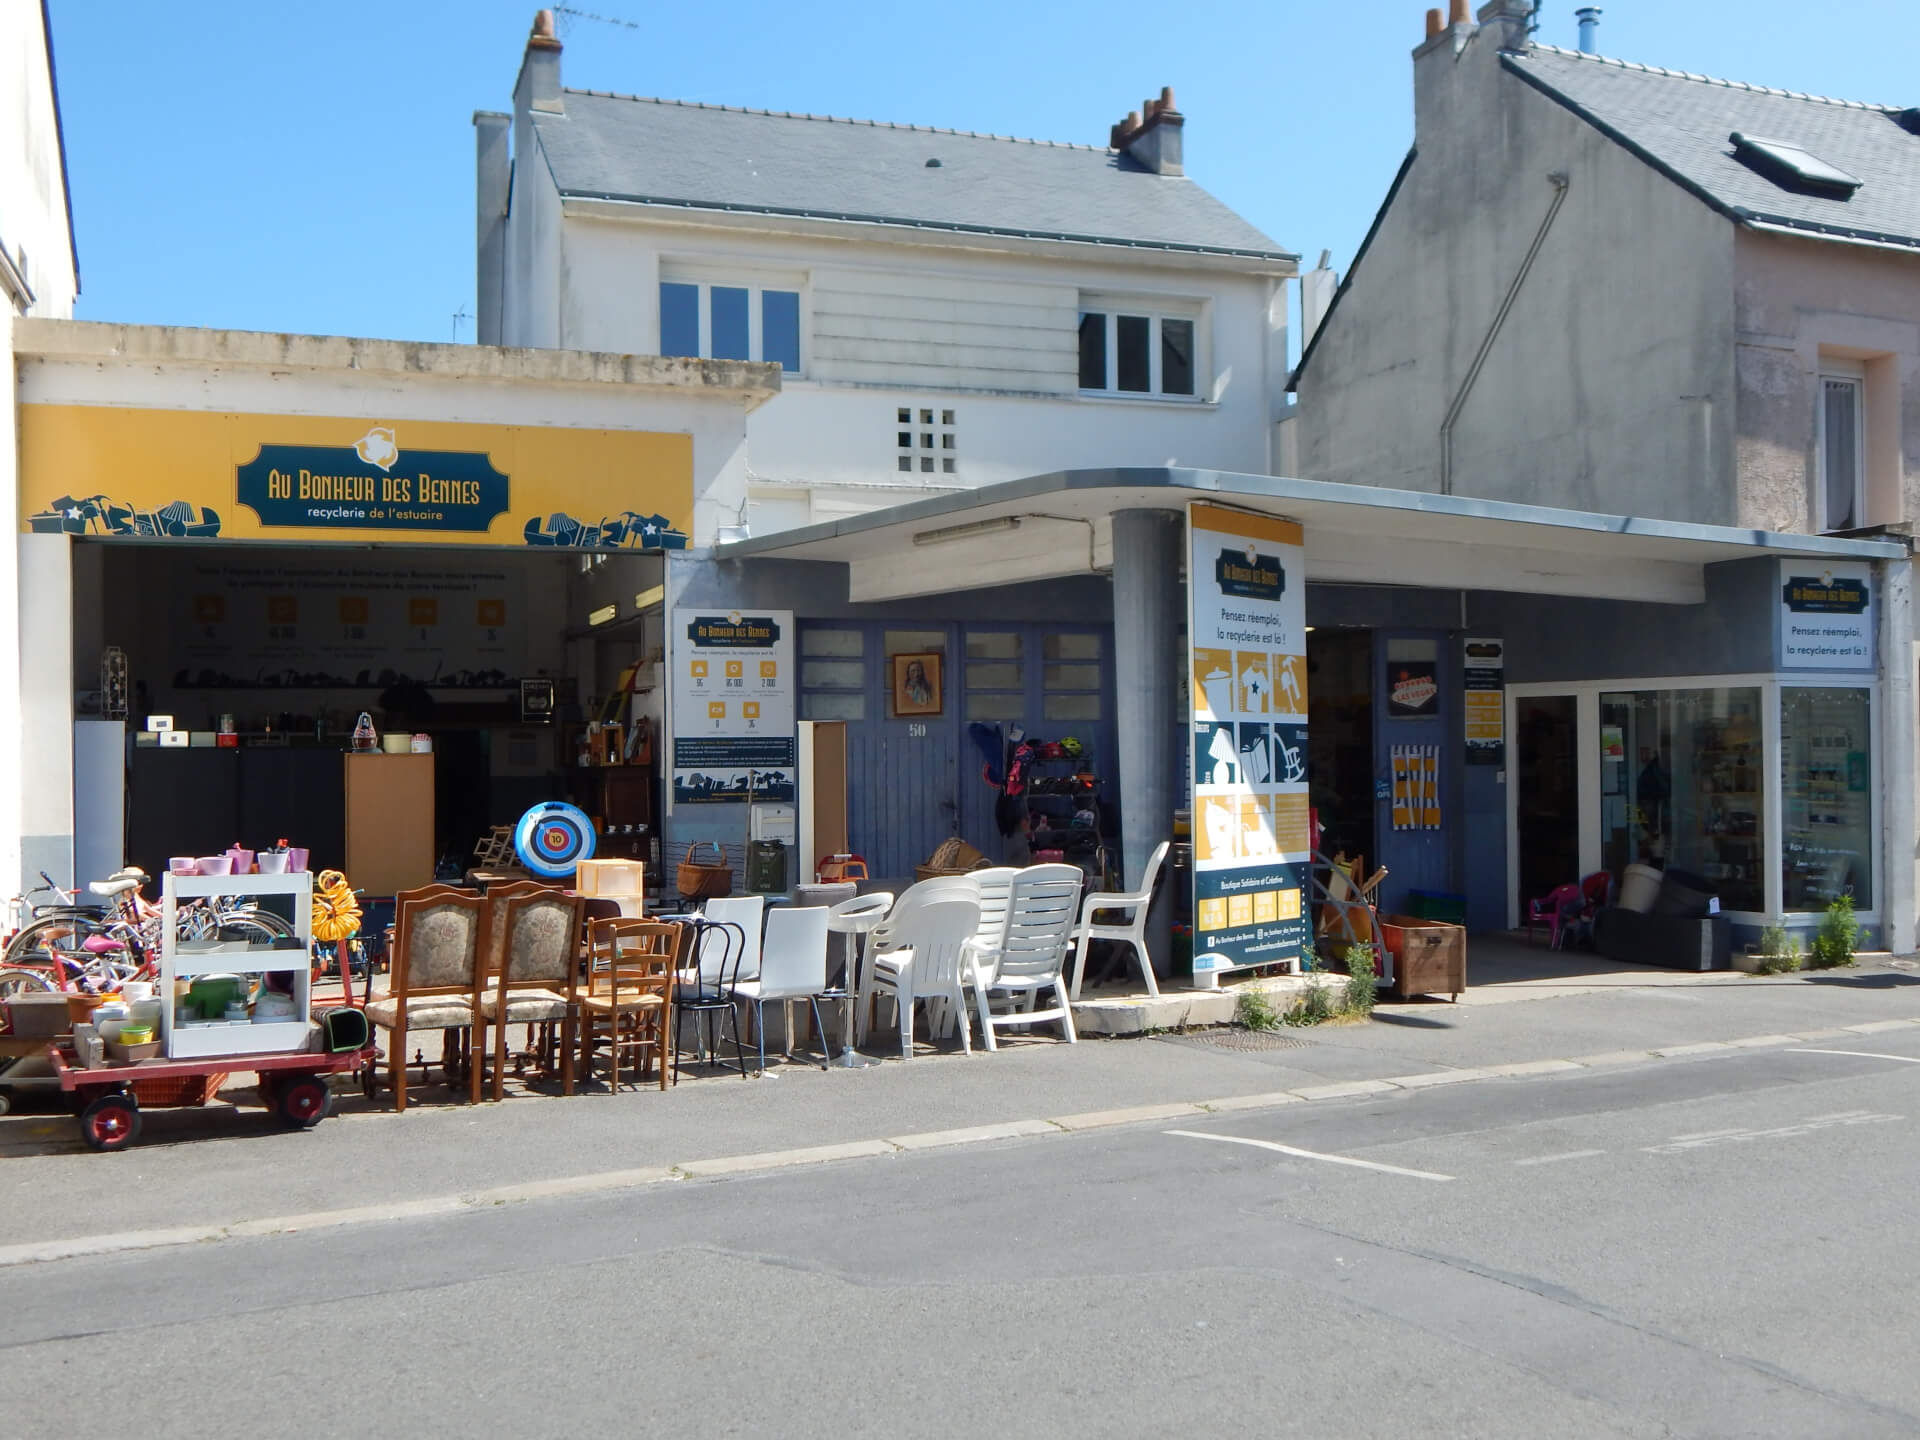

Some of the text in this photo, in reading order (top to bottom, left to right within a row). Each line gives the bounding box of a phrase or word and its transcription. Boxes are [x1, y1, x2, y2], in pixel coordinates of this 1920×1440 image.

[308, 507, 443, 520] recyclerie de l'estuaire
[1222, 608, 1246, 622] Pensez
[1217, 626, 1225, 639] la
[1226, 629, 1260, 644] recyclerie
[1263, 633, 1273, 643] est
[1792, 626, 1819, 636] Pensez
[1787, 644, 1795, 654] la
[1797, 645, 1837, 656] recyclerie
[1840, 647, 1851, 655] est
[909, 723, 926, 737] 50
[552, 835, 561, 844] 10
